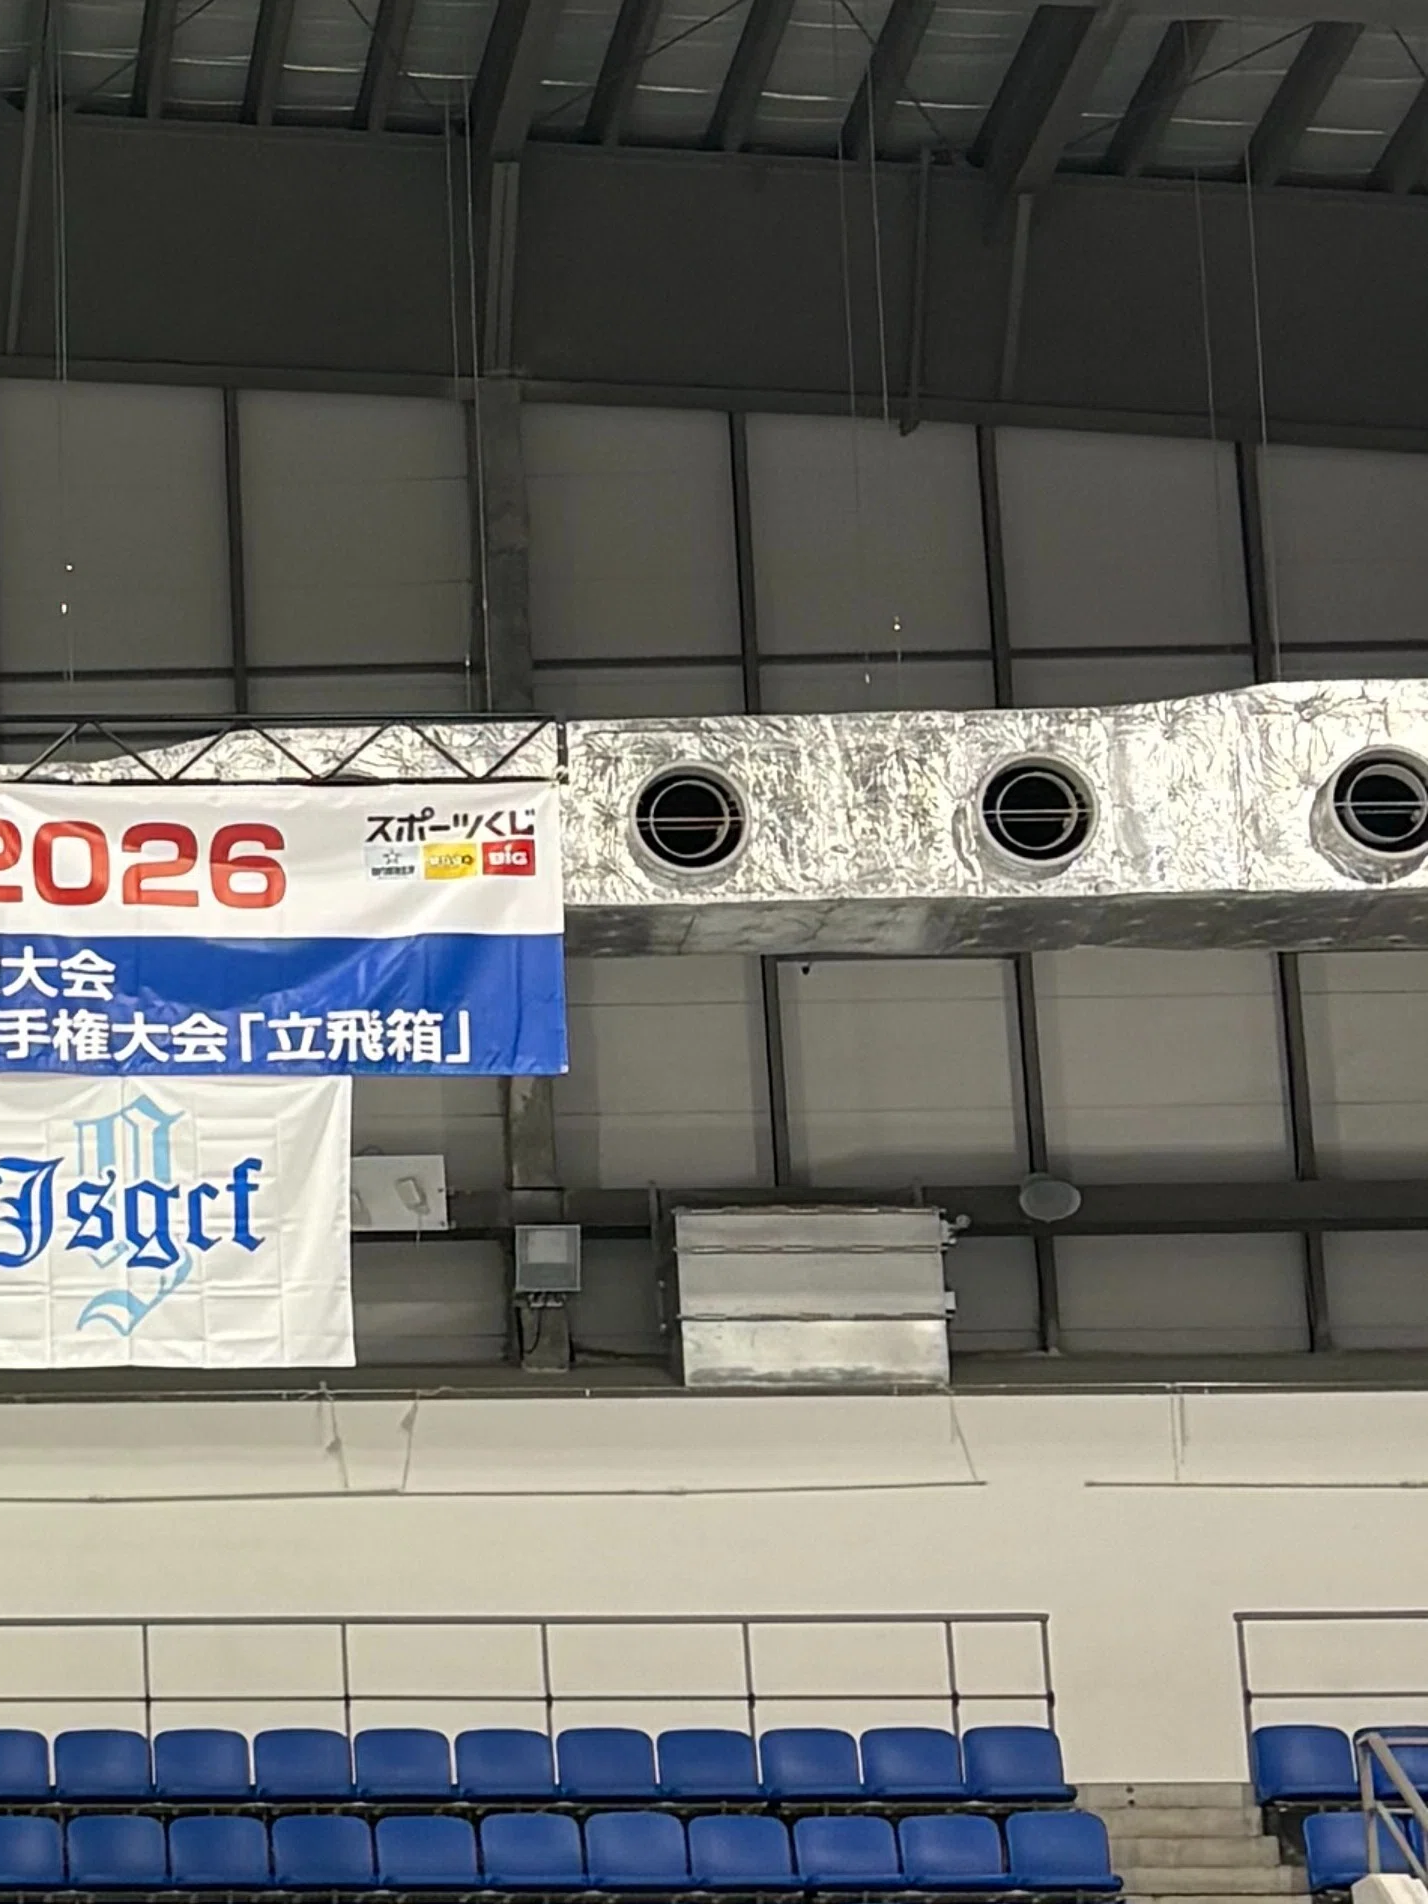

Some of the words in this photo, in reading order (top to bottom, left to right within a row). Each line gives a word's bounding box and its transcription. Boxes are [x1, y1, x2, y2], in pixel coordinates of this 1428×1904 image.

[366, 807, 535, 843] スポーツくじ
